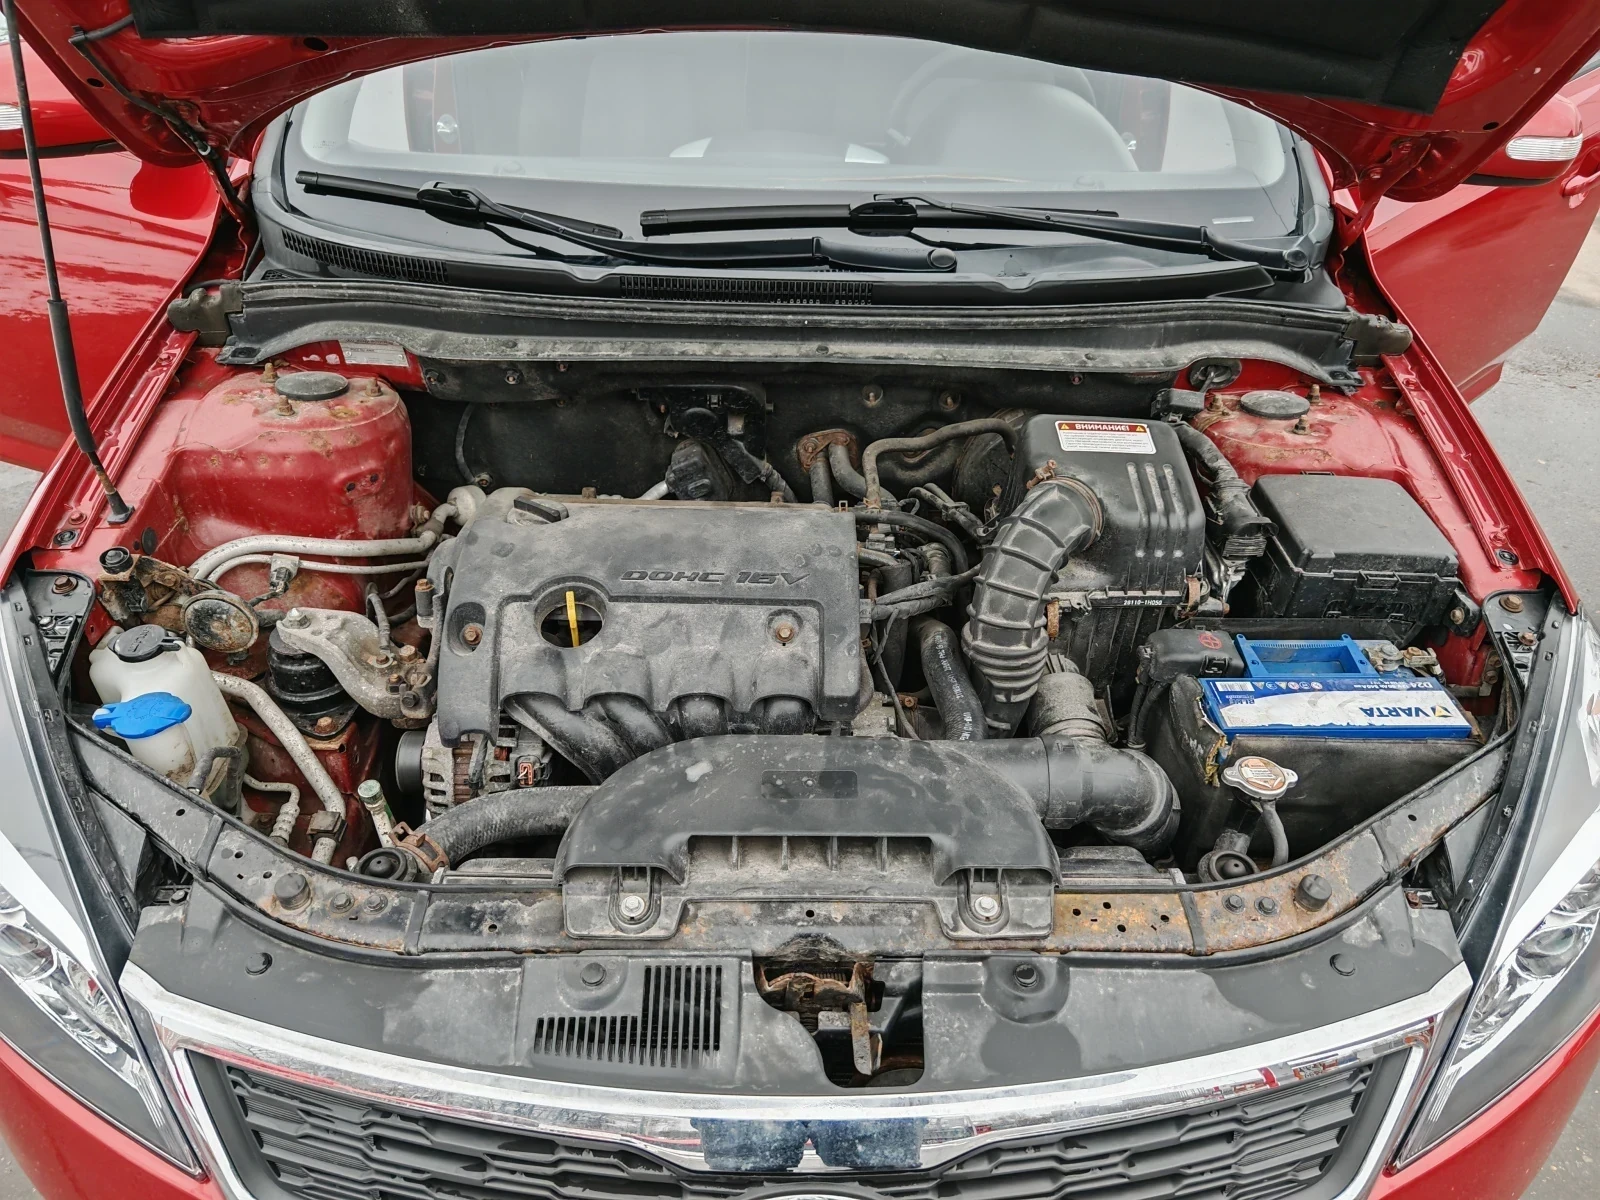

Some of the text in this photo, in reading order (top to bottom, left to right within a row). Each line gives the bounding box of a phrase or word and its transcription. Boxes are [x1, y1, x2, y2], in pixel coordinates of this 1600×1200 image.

[1075, 423, 1130, 432] ВНИМАНИЕ!
[620, 570, 811, 586] DOHC 16V
[1409, 681, 1433, 689] D24
[1358, 707, 1431, 718] VARTA
